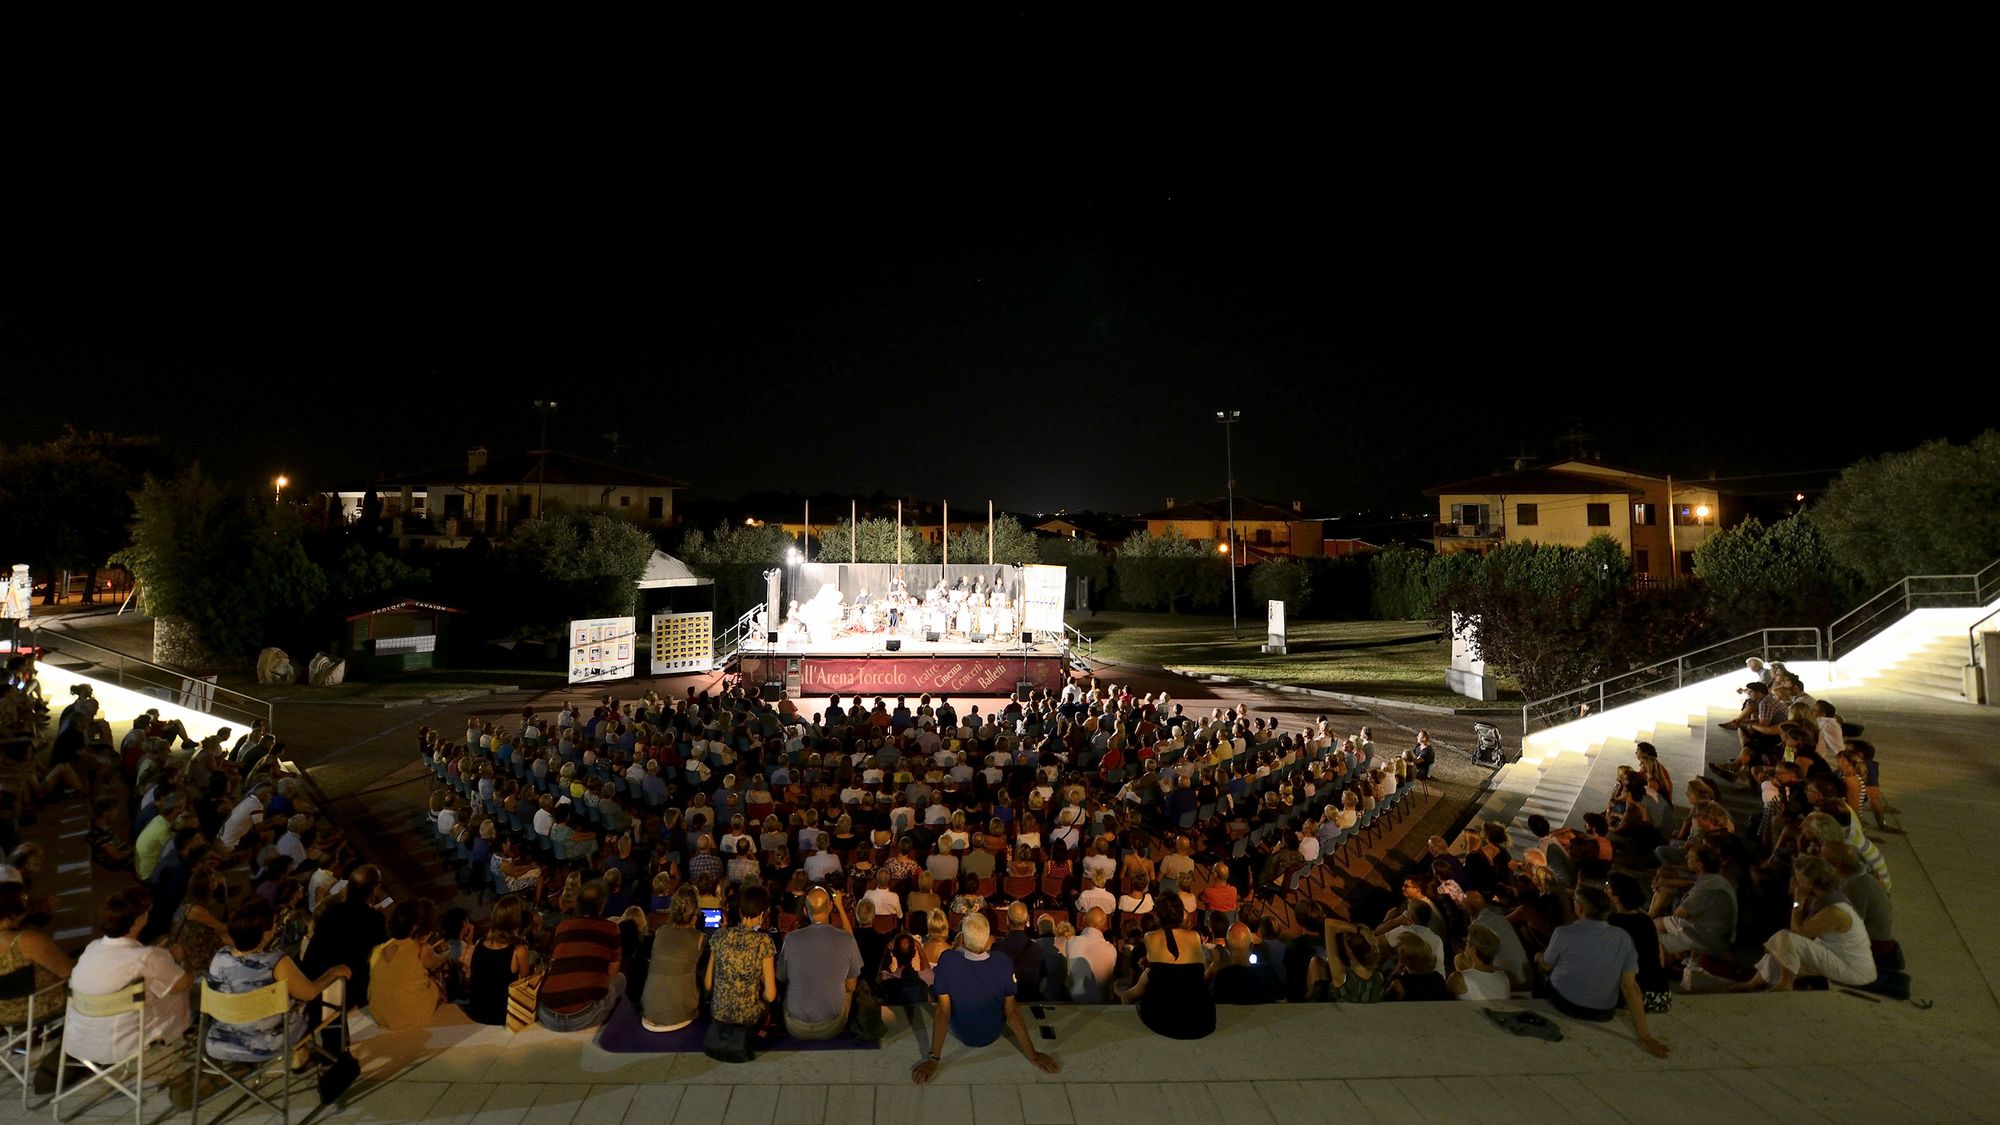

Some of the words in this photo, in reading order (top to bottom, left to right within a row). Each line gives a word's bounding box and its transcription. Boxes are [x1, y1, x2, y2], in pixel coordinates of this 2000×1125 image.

[857, 664, 907, 685] Torcolo
[912, 663, 940, 687] Teatro
[934, 663, 963, 688] Cinema
[951, 661, 983, 691] Concerti
[977, 662, 1007, 689] Balletti
